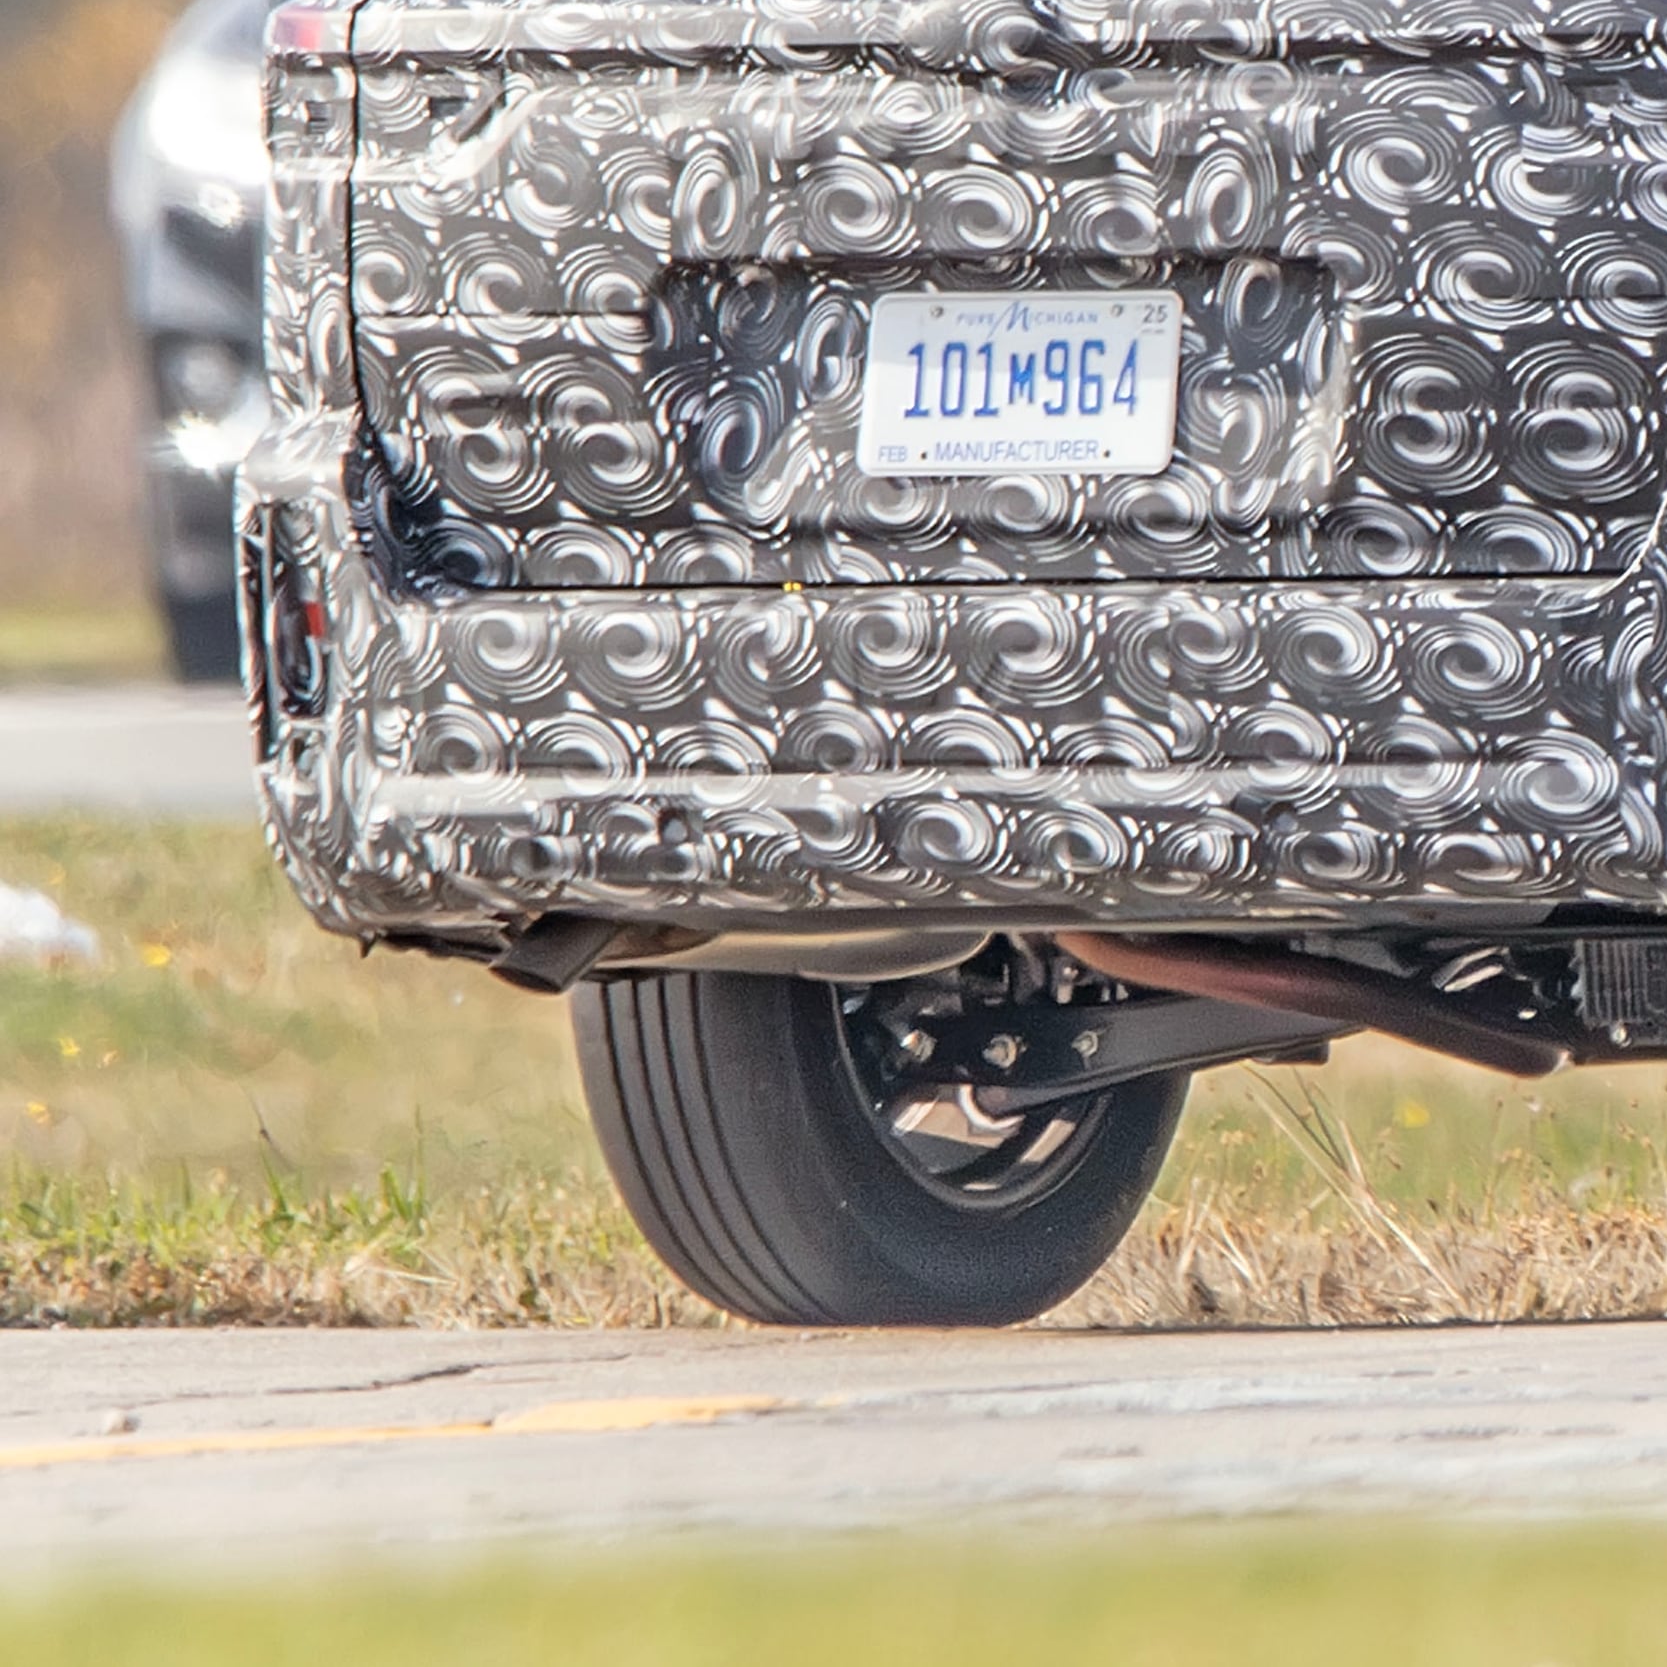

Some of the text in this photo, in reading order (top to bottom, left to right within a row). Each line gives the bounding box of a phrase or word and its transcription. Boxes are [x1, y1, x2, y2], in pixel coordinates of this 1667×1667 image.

[1142, 304, 1168, 323] 25
[904, 338, 1139, 418] 101M964
[878, 445, 907, 463] FEB
[934, 440, 1099, 462] MANUFACTURER
